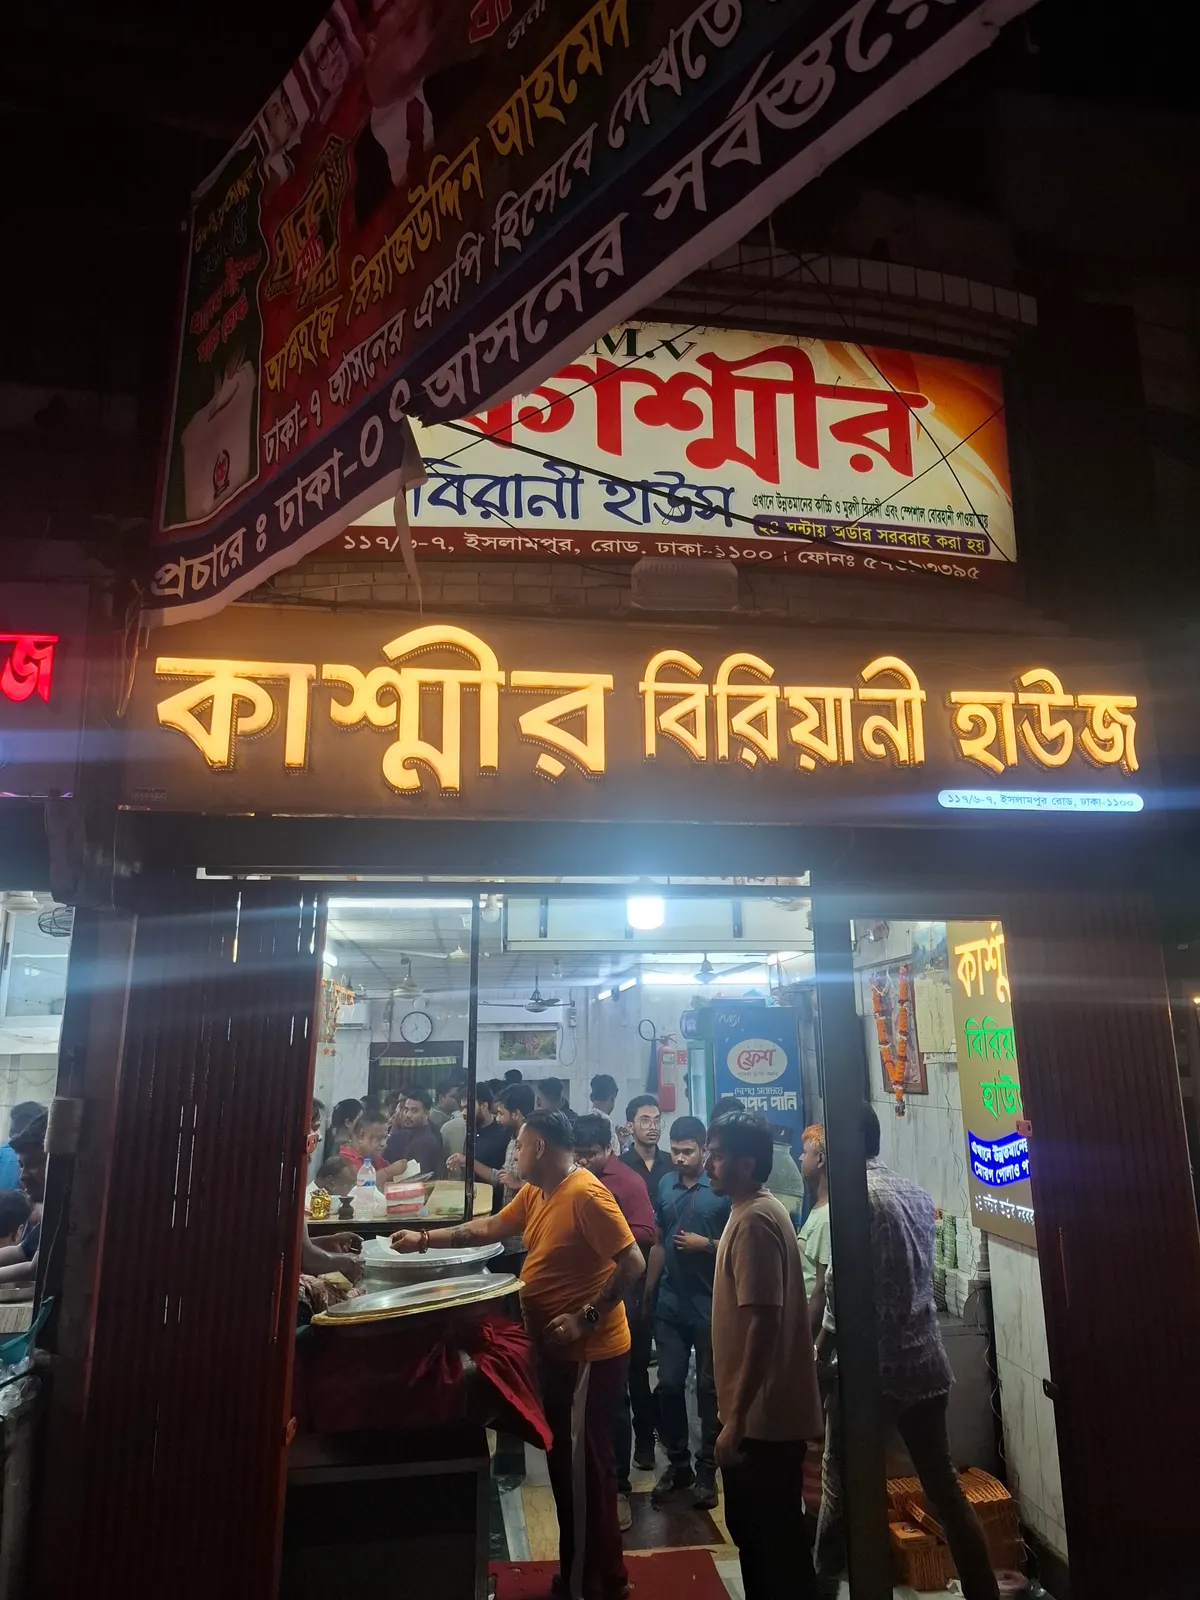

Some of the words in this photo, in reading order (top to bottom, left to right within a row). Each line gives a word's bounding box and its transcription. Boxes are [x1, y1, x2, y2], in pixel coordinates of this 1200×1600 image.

[485, 0, 630, 157] আহমেদ
[328, 308, 407, 407] আসনের
[413, 231, 486, 330] এমপি
[491, 122, 599, 268] হিসেবে
[421, 211, 630, 408] আসনের
[343, 535, 455, 554] ১১৭/-৭,
[831, 521, 872, 543] অর্ডার
[876, 529, 931, 548] সরবরাহ
[934, 535, 961, 553] করা
[966, 538, 985, 555] হয়
[835, 500, 841, 513] ও
[155, 624, 615, 794] কাশ্মীর
[638, 649, 926, 771] বিরিয়ানী
[948, 668, 1138, 775] হাউজ
[1000, 793, 1048, 807] ইসলামপুর
